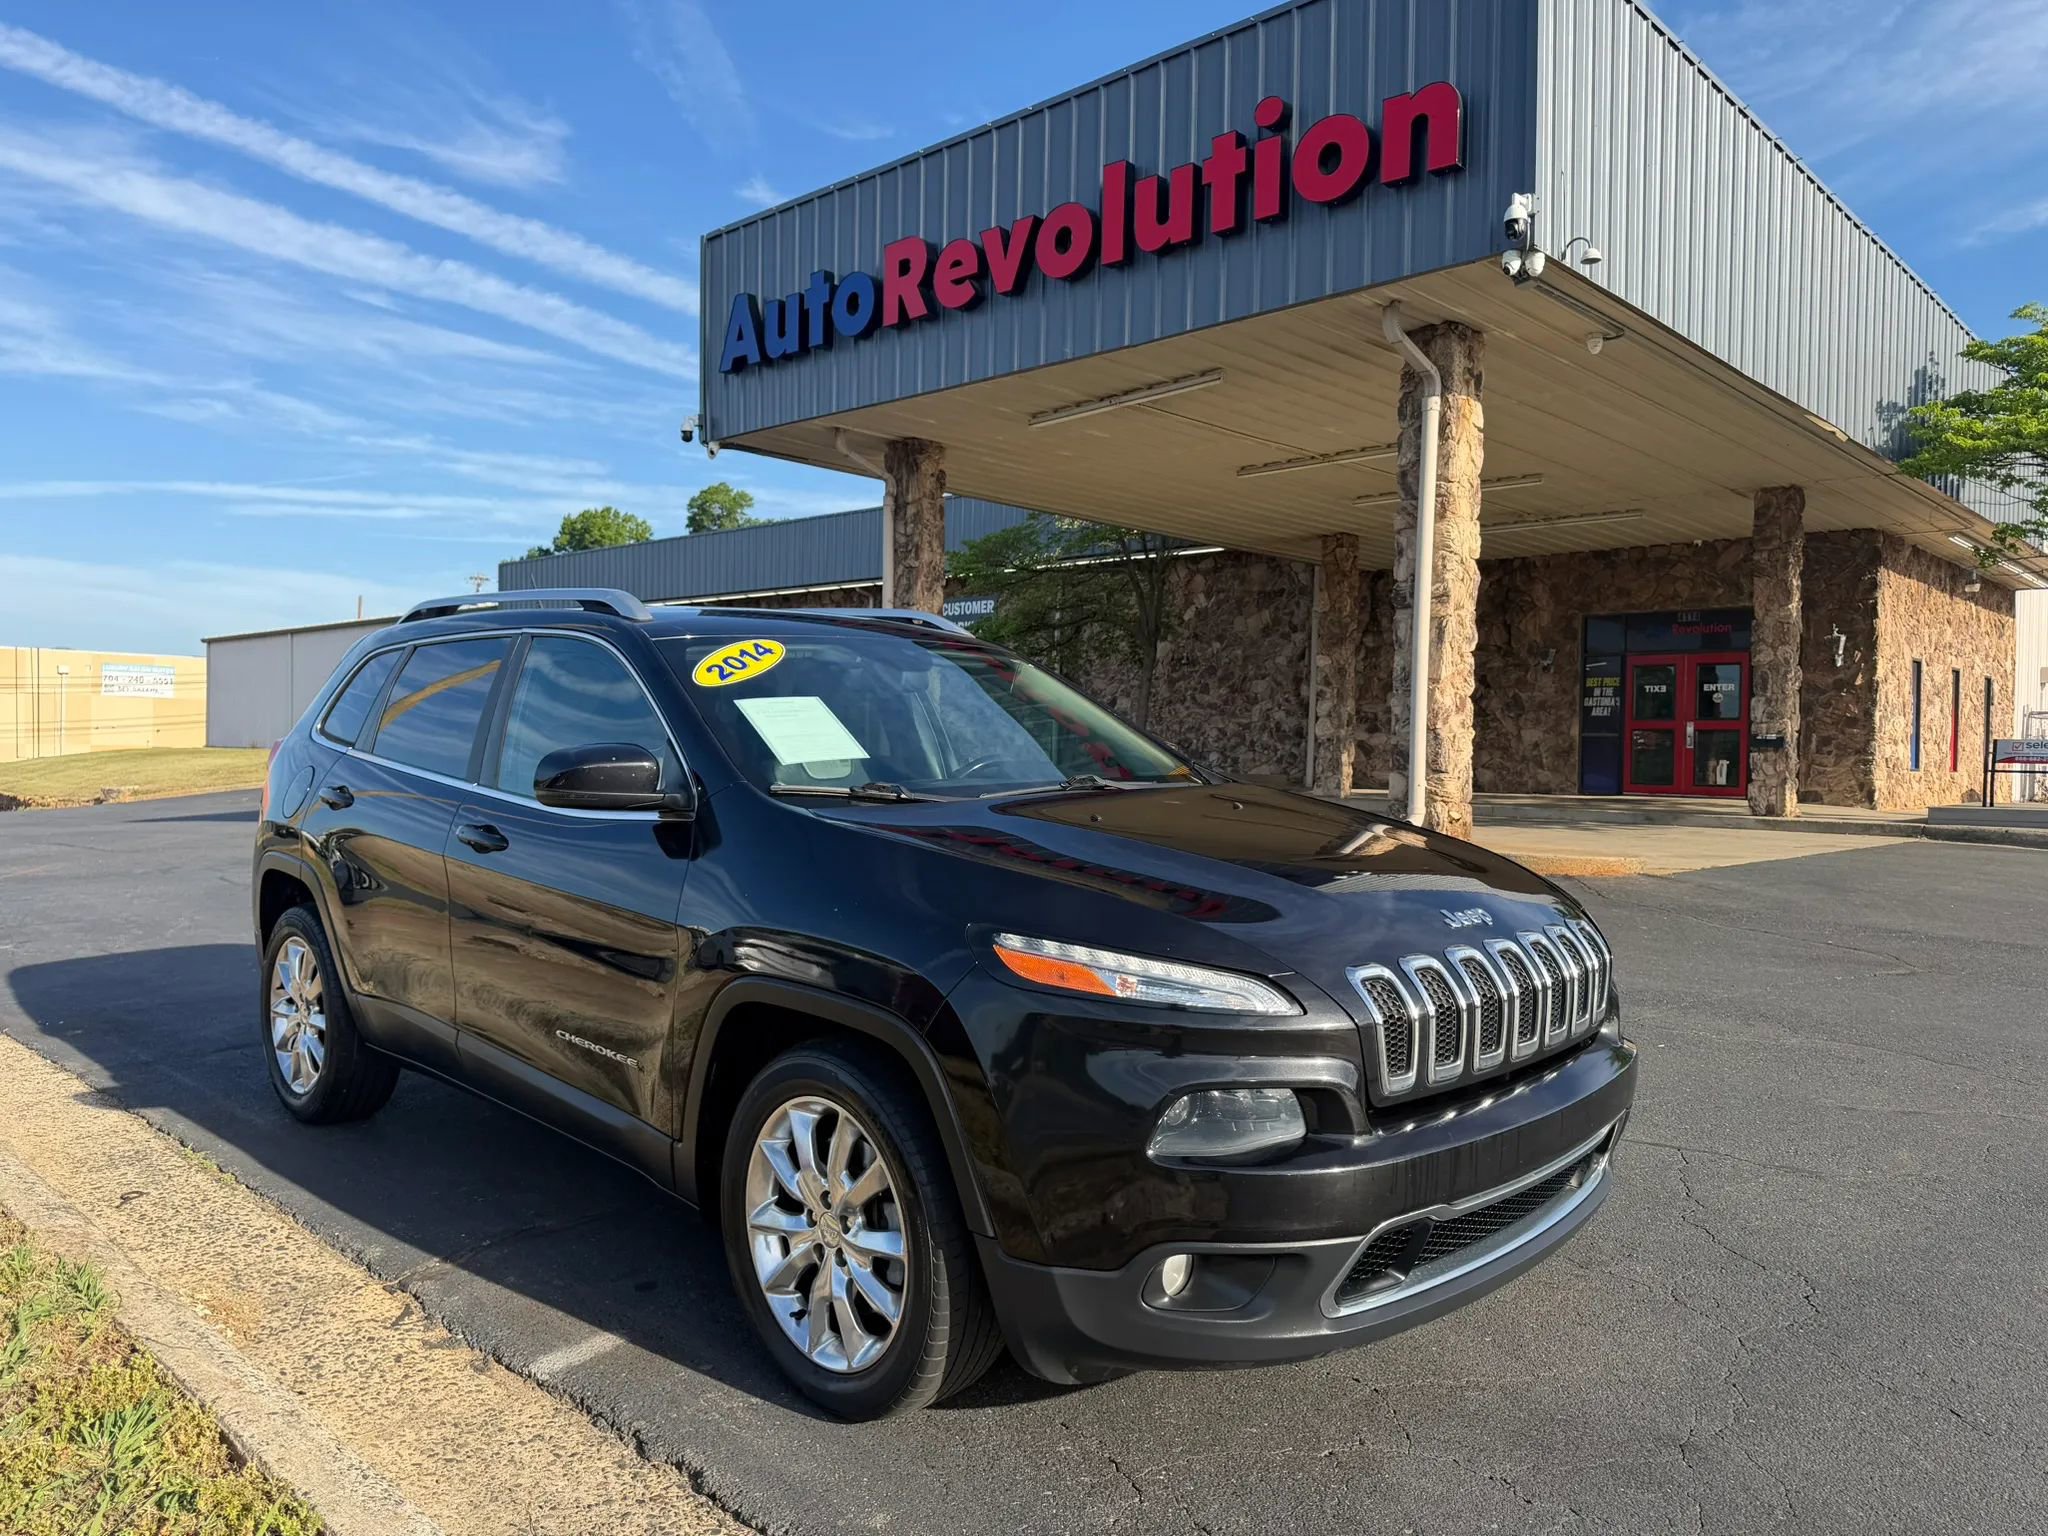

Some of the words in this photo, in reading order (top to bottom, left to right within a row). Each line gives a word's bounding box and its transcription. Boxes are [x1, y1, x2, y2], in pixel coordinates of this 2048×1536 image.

[942, 599, 995, 617] CUSTOMER
[706, 642, 775, 682] 2014
[1585, 677, 1602, 687] BEST
[1602, 677, 1620, 686] PRICE
[1703, 683, 1735, 692] ENTER
[1602, 687, 1614, 696] THE
[1591, 706, 1611, 717] AREA!
[1439, 907, 1493, 928] Jeep
[555, 1029, 639, 1069] CHEROKEE
